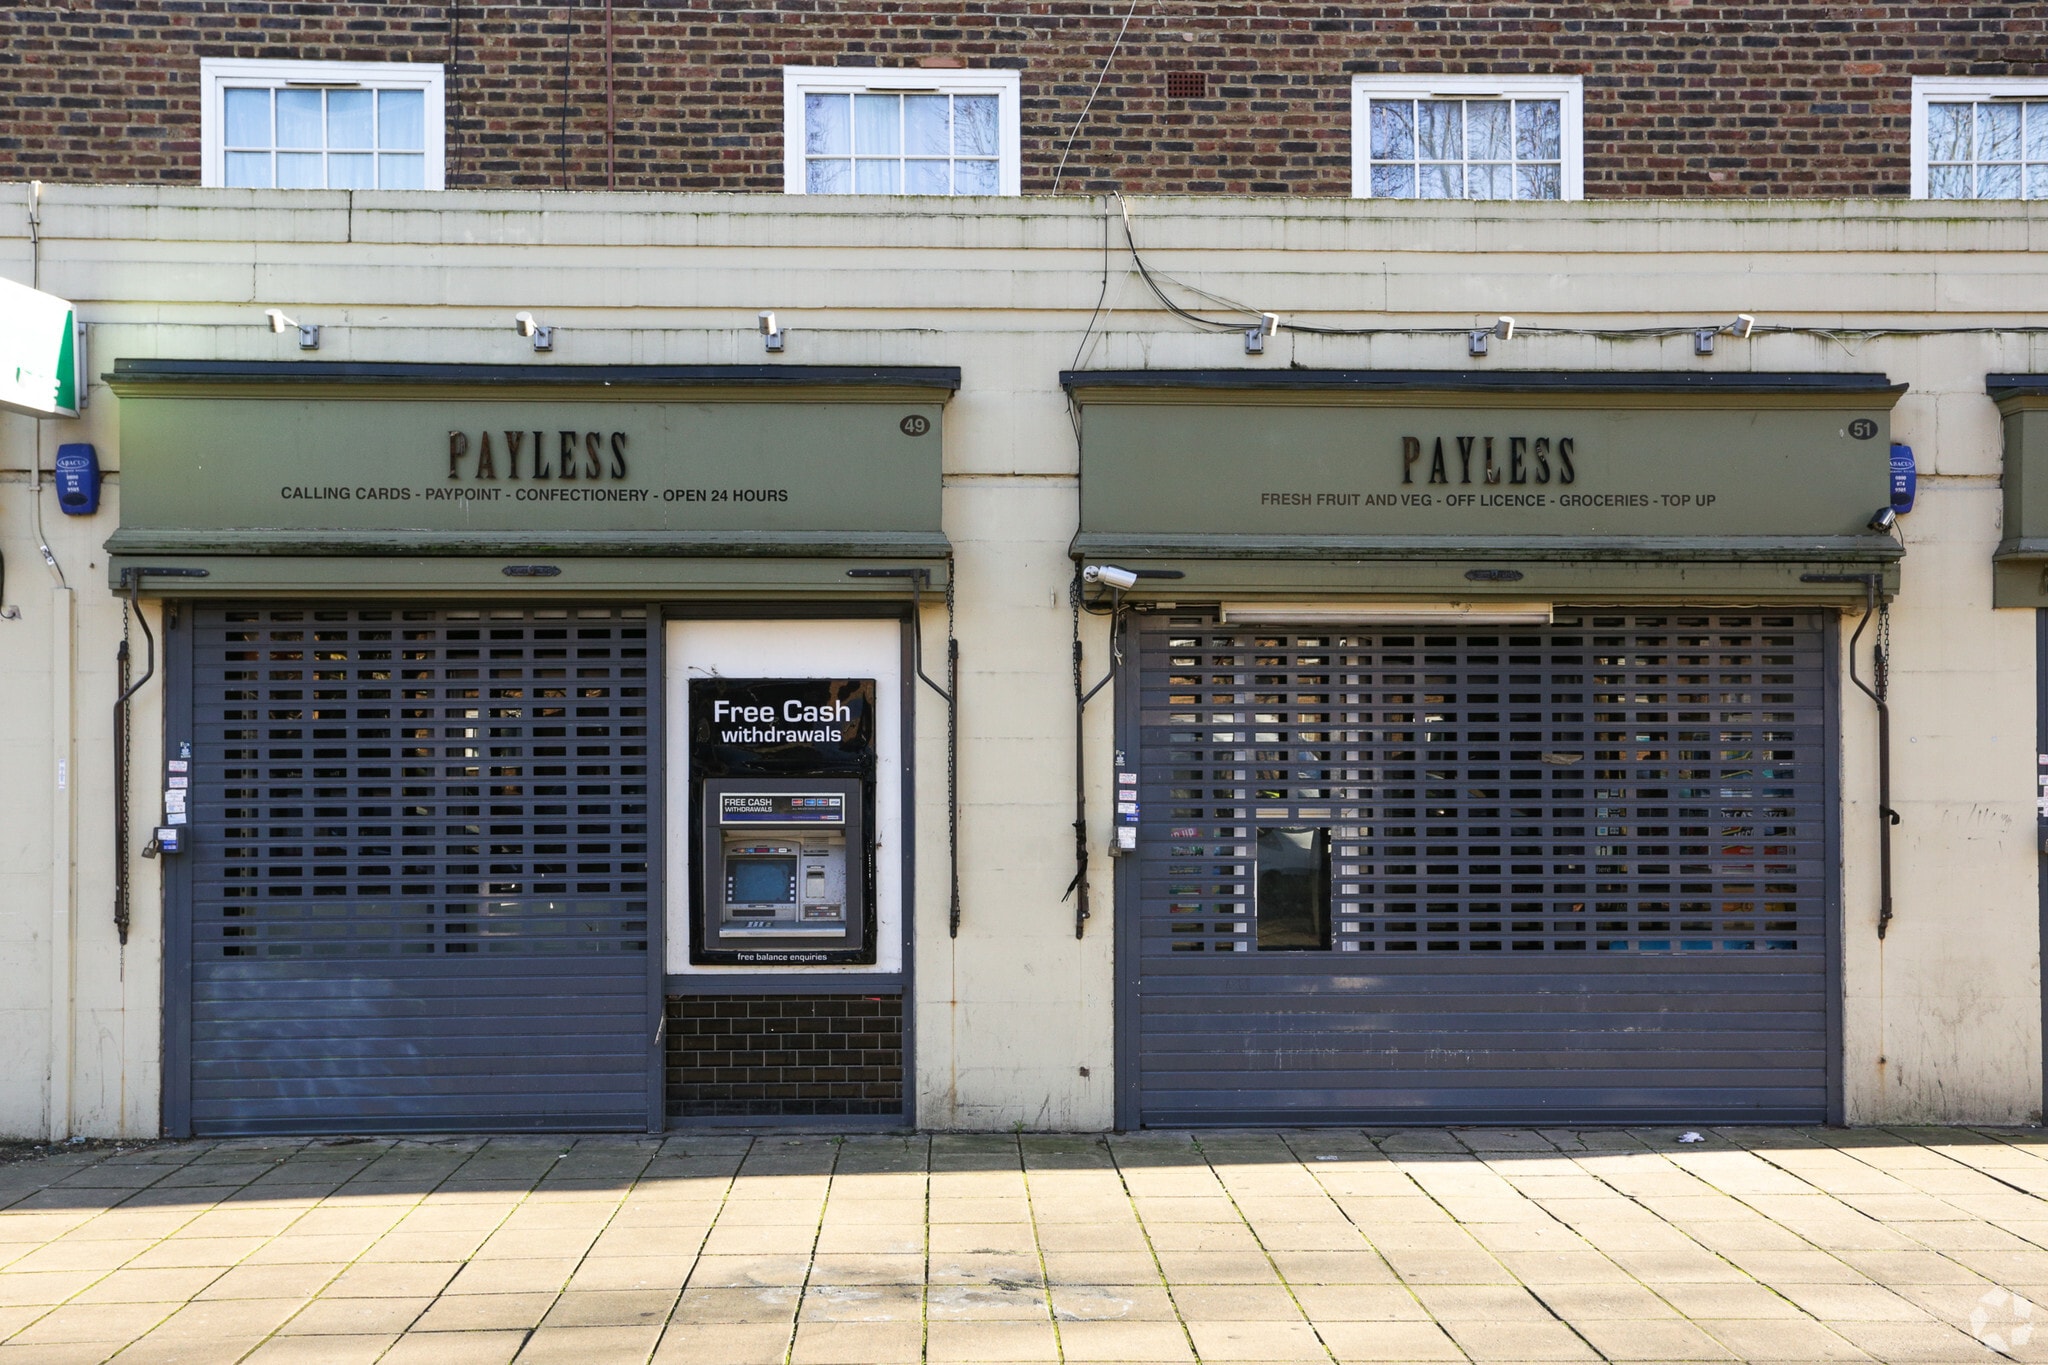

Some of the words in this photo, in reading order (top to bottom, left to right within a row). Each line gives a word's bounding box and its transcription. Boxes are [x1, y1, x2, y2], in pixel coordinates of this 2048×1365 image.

[904, 418, 925, 433] 49
[1853, 422, 1871, 437] 51
[447, 430, 629, 481] PAYLESS
[1401, 436, 1576, 485] PAYLESS
[281, 486, 351, 500] CALLING
[355, 487, 411, 501] CARDS
[425, 487, 502, 501] PAYPOINT
[515, 488, 650, 502] CONFECTIONERY
[662, 488, 707, 502] OPEN
[711, 489, 729, 502] 24
[732, 489, 789, 503] HOURS
[1261, 493, 1312, 506] FRESH
[1316, 493, 1361, 506] FRUIT
[1364, 493, 1398, 506] AND
[1400, 493, 1432, 507] VEG
[1445, 493, 1476, 507] OFF
[1480, 494, 1546, 507] LICENCE
[1559, 494, 1649, 507] GROCERIES
[1660, 494, 1691, 507] TOP
[1695, 494, 1716, 507] UP
[714, 700, 775, 723] Free
[783, 699, 851, 723] Cash
[721, 725, 842, 743] withdrawals
[724, 798, 746, 806] FREE
[748, 798, 772, 806] CASH
[737, 952, 755, 961] free
[756, 952, 788, 961] balance
[790, 952, 827, 963] enquiries
